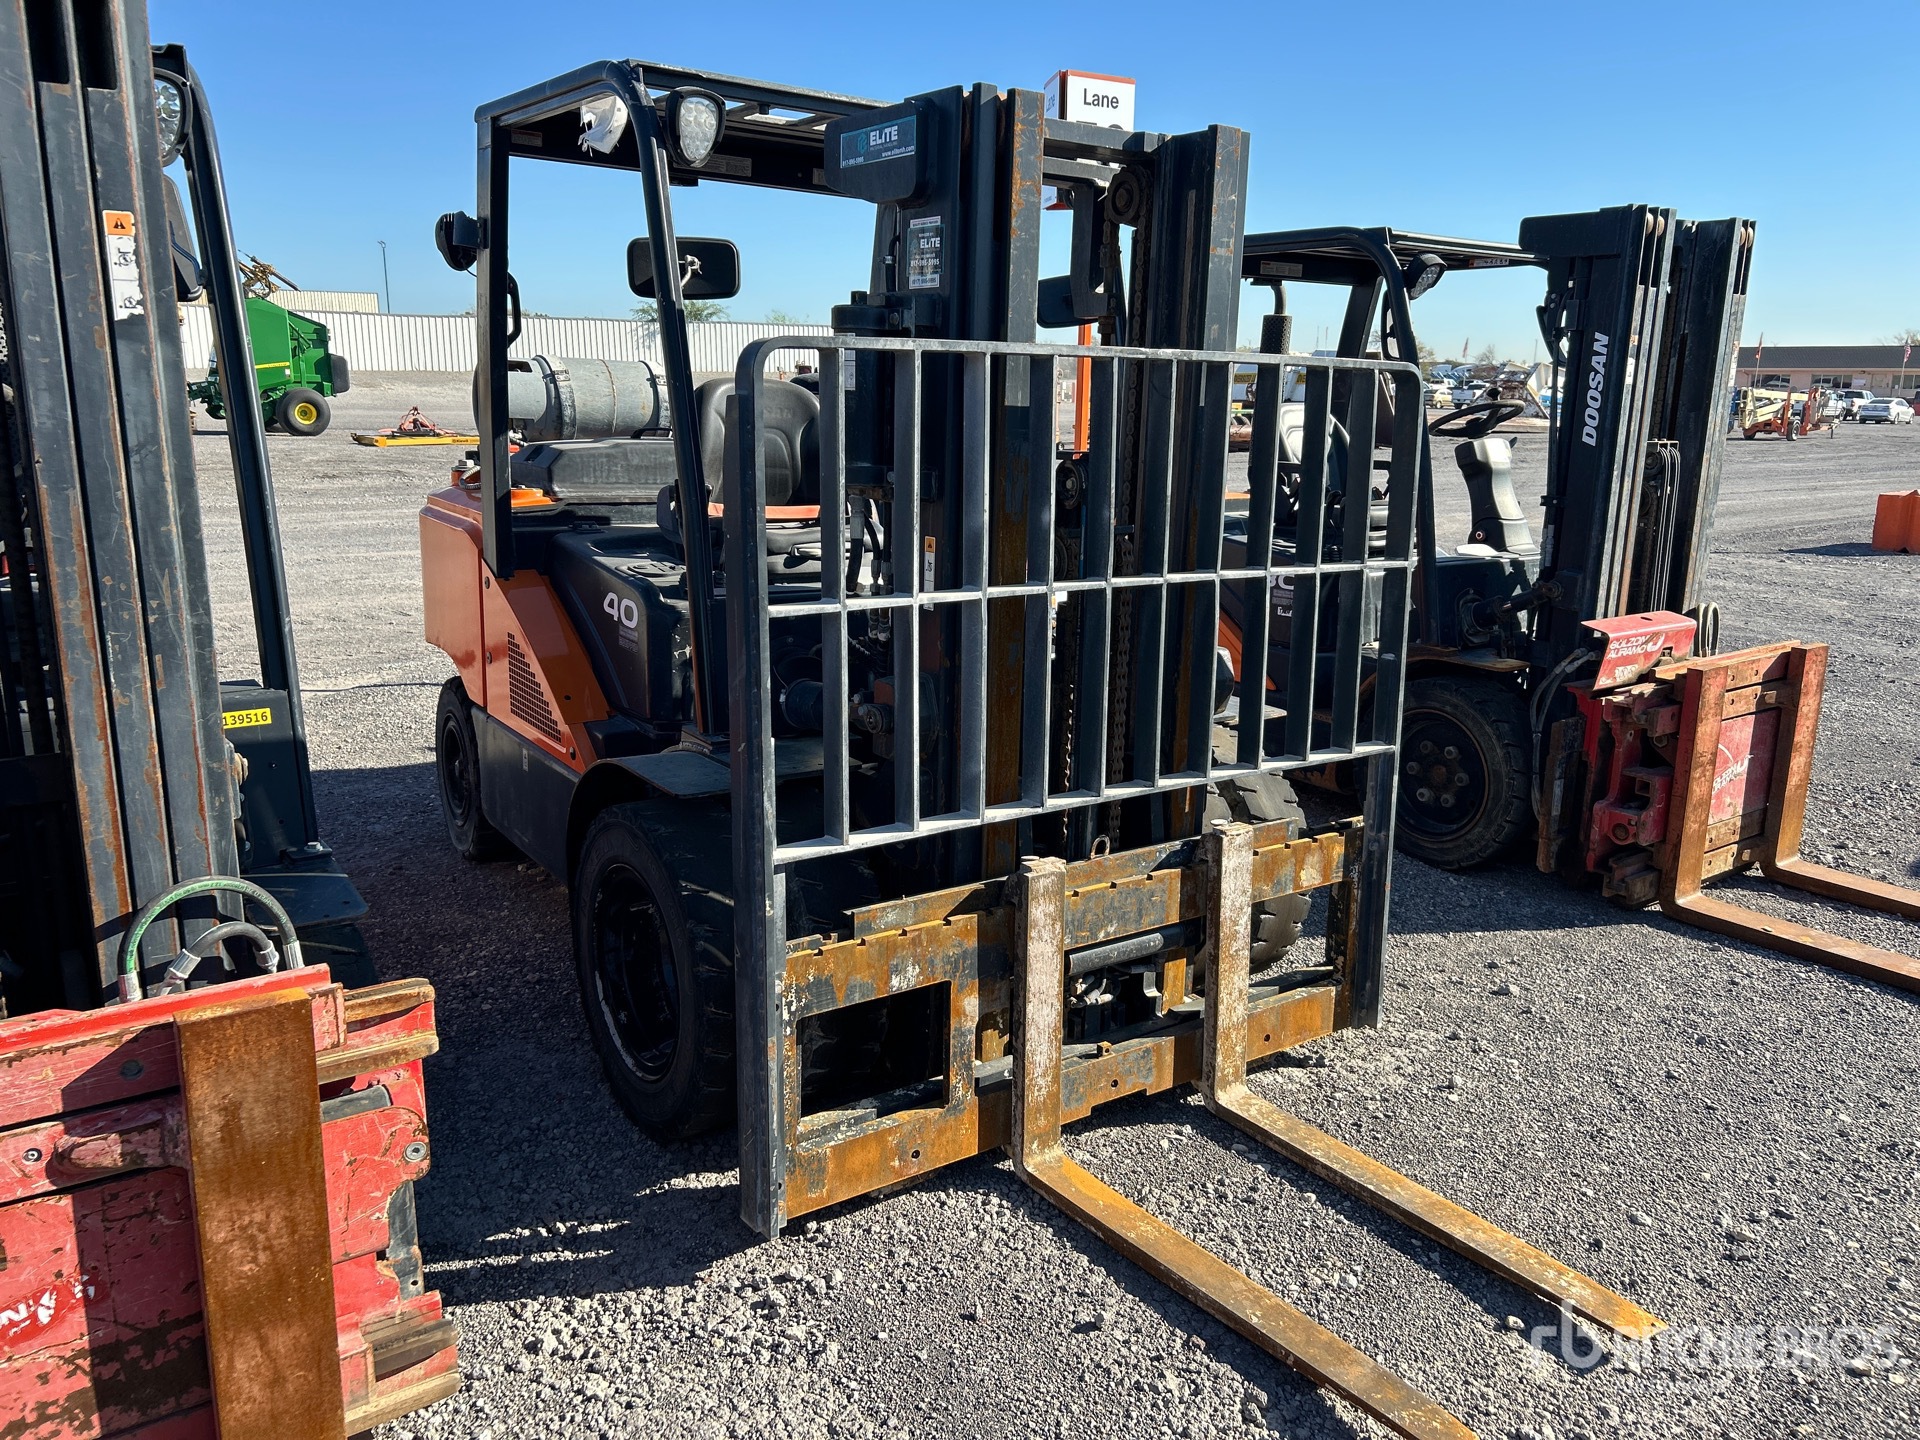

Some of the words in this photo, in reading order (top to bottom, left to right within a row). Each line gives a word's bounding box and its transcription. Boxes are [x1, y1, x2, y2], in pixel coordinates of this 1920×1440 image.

[1083, 87, 1120, 110] Lane
[869, 125, 899, 147] ELITE
[920, 237, 941, 249] ELITE
[1582, 331, 1609, 447] DOOSAN
[603, 591, 639, 629] 40
[222, 711, 268, 727] 139516
